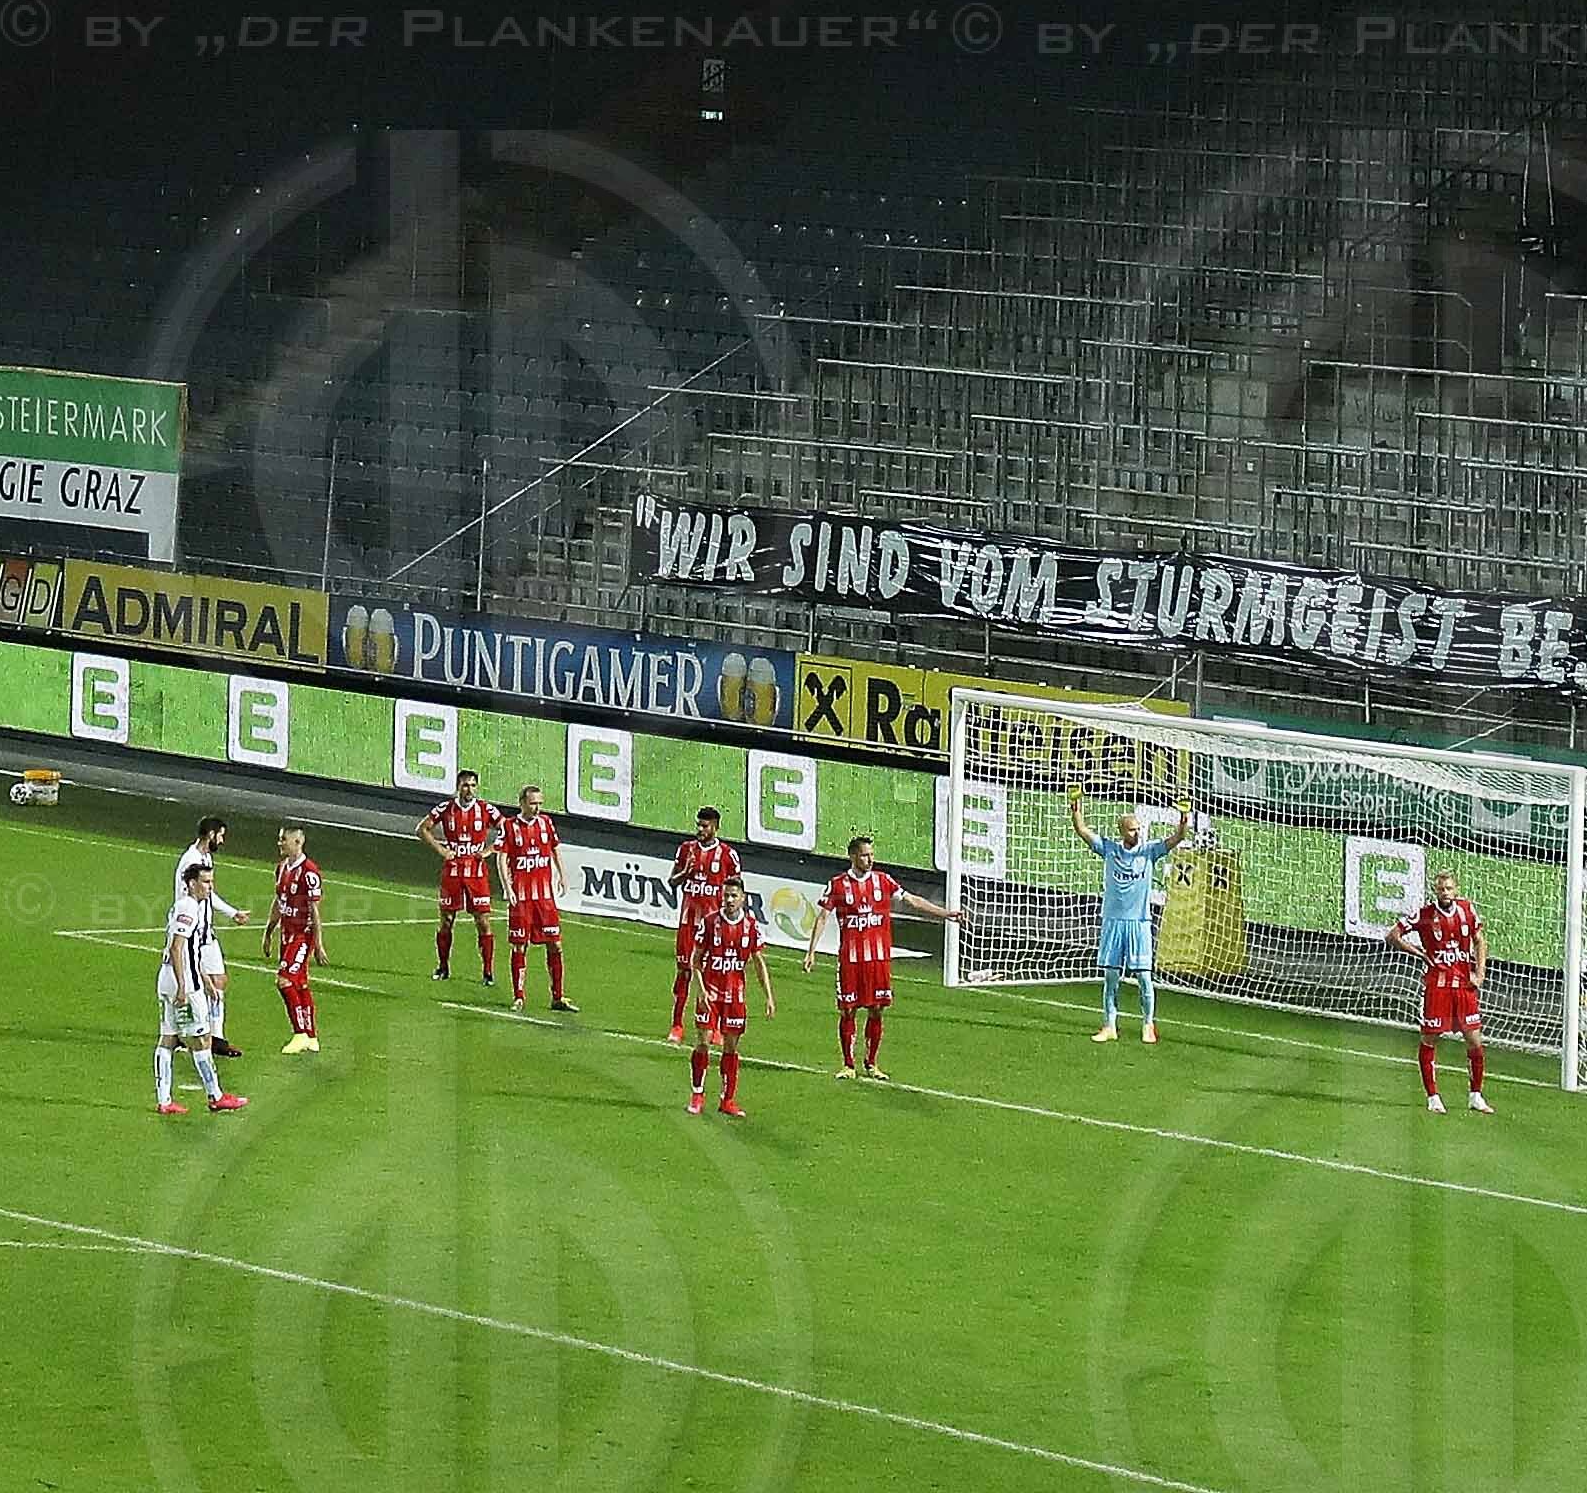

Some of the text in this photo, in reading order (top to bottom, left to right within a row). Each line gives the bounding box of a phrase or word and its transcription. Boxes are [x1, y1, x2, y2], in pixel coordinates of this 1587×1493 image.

[59, 466, 148, 515] GRAZ
[70, 575, 320, 665] ADMIRAL
[782, 521, 910, 600] SIND
[940, 539, 1058, 624] VOM
[1086, 556, 1467, 670] STURMGEIST
[83, 666, 121, 729] E
[410, 610, 705, 720] PUNTIGAMER
[239, 690, 278, 754] E
[406, 714, 446, 779] E
[579, 739, 621, 808] E
[761, 765, 804, 835] E
[516, 856, 550, 873] Zipfer
[579, 862, 770, 927] MÜNR
[683, 880, 720, 897] Zipfer
[846, 912, 884, 931] Zipfer
